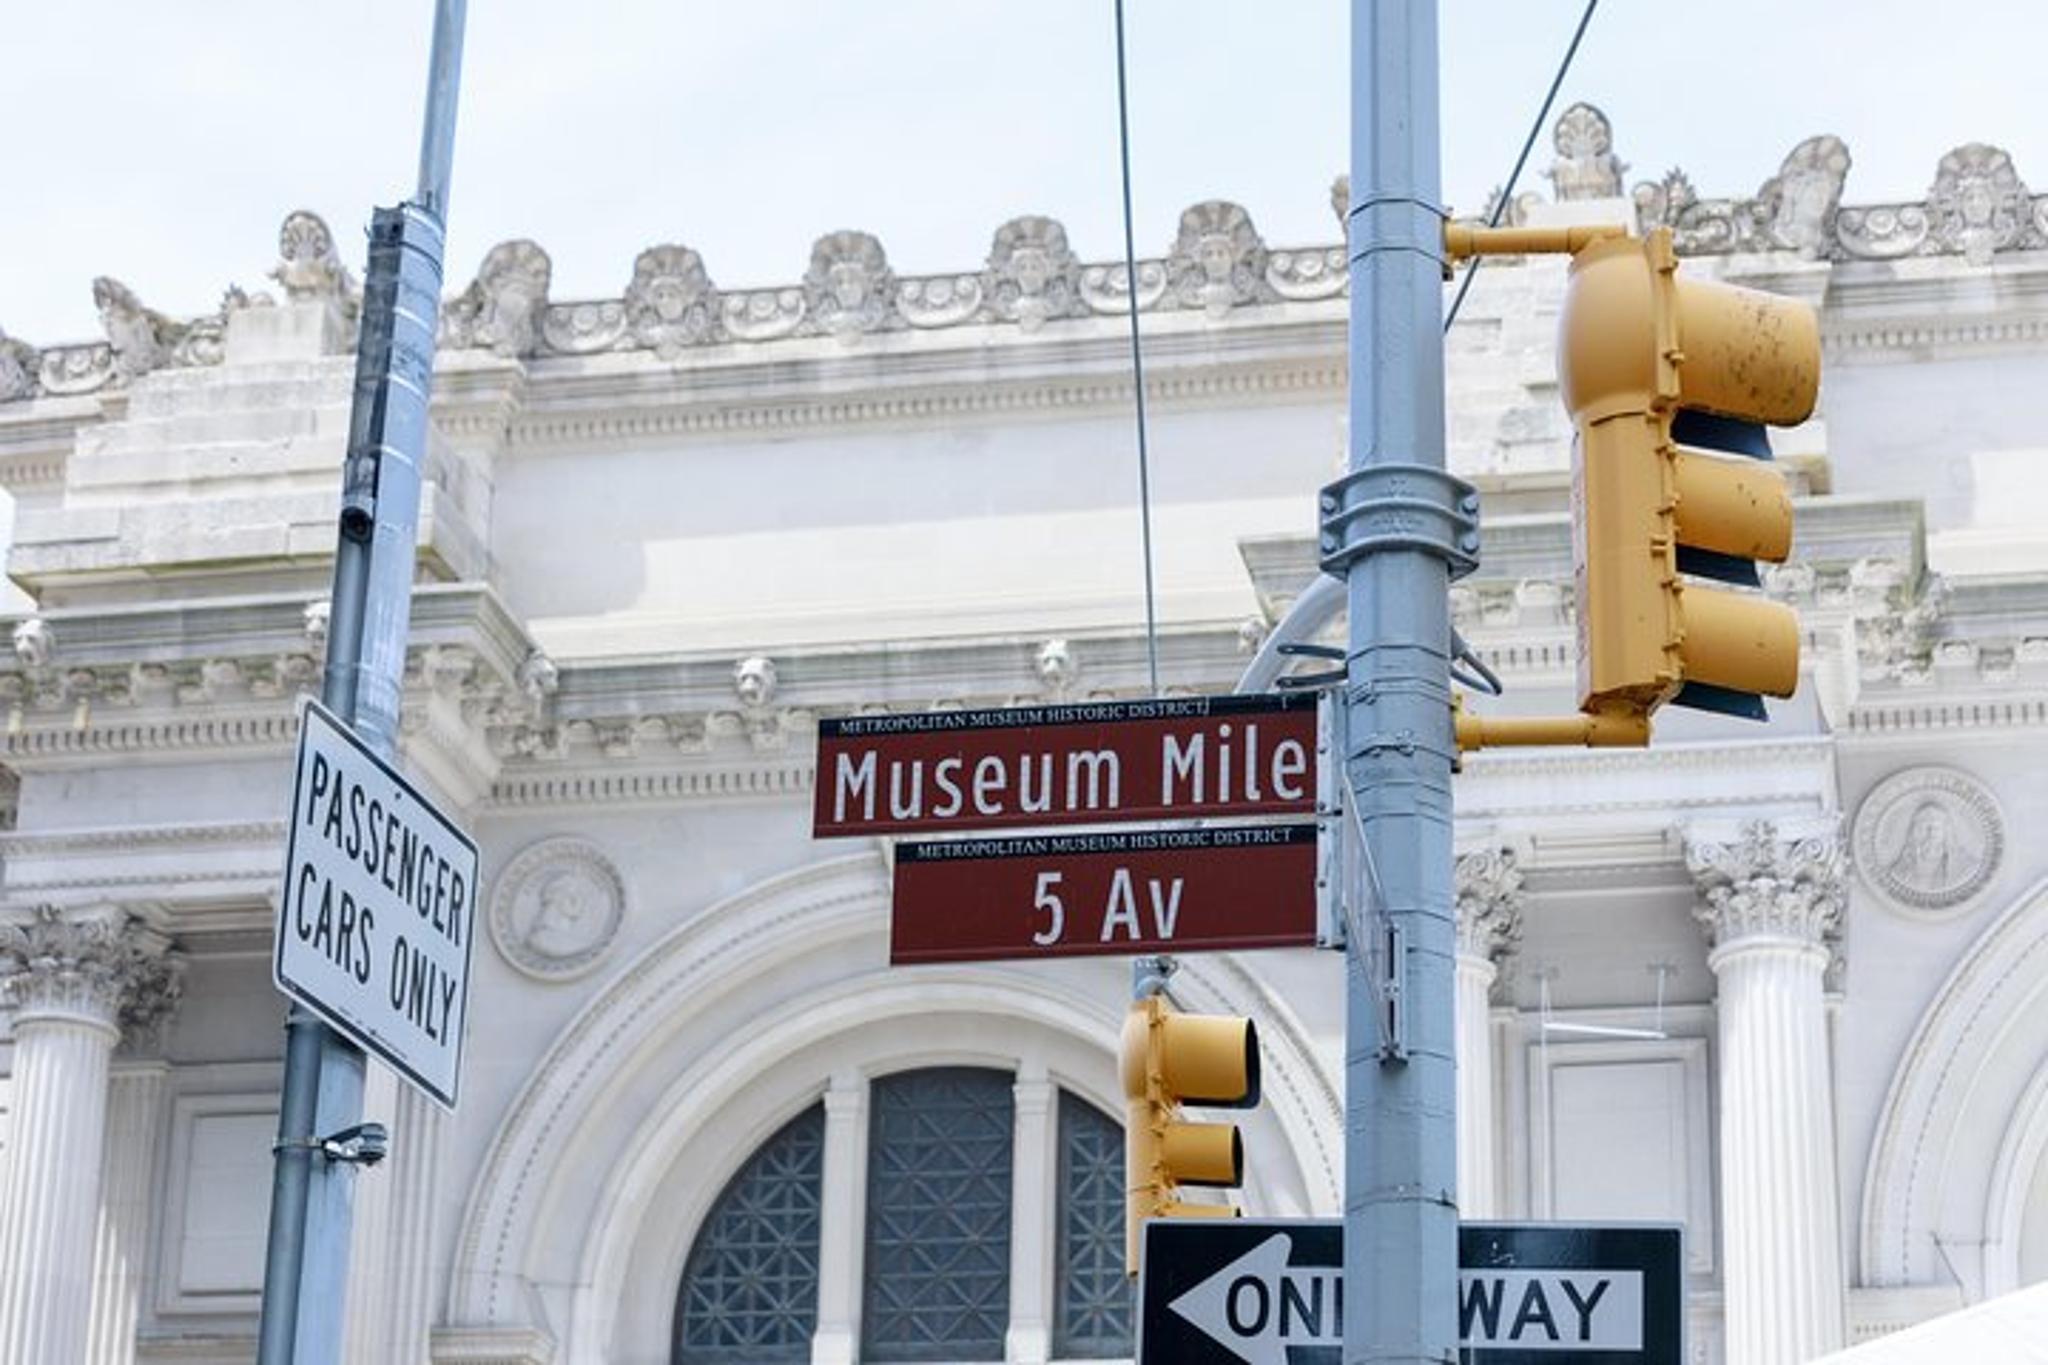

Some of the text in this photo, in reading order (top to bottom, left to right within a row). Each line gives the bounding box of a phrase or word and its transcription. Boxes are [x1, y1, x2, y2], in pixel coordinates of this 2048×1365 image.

[840, 713, 966, 733] METROPOLITAN
[970, 709, 1043, 727] MUSEUM
[1047, 705, 1122, 722] HISTORIC
[834, 723, 1307, 823] Museum Mile
[307, 750, 465, 947] PASSENGER
[917, 827, 1293, 858] METROPOLITAN MUSEUM HISTORIC DISTRICT
[1034, 868, 1184, 946] 5 Av
[297, 863, 374, 985] CARS
[390, 935, 456, 1047] ONLY
[1459, 1278, 1611, 1341] WAY
